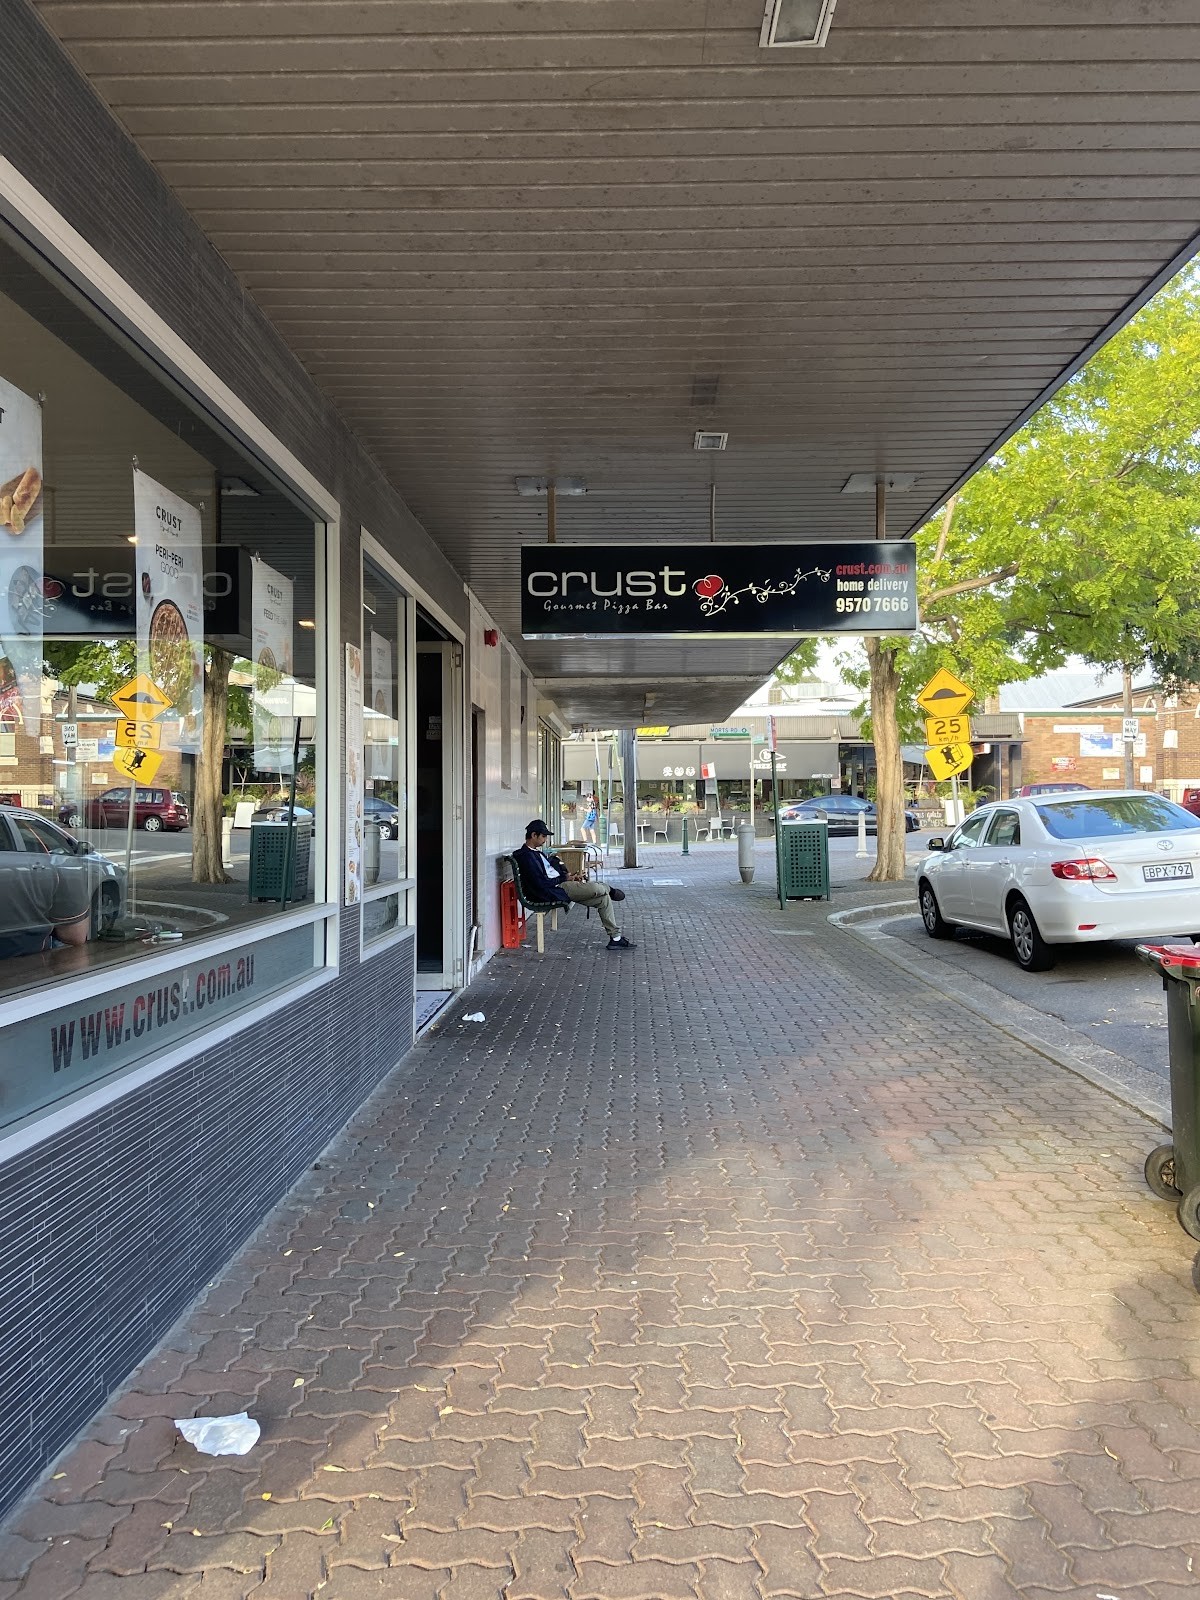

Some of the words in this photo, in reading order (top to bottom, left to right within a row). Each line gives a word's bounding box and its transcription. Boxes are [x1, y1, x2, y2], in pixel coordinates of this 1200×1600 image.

[155, 505, 182, 531] CRUST
[155, 543, 184, 568] PERI-PERI
[835, 562, 909, 576] crust.com.au
[527, 565, 687, 597] crust
[836, 578, 865, 592] home
[867, 578, 909, 593] delivery
[543, 599, 598, 611] Gourmet
[603, 598, 640, 615] Pizza
[645, 599, 669, 611] Bar
[835, 597, 872, 613] 9570
[873, 596, 909, 612] 7666
[934, 718, 961, 735] 25
[1125, 719, 1137, 727] ONE
[938, 735, 959, 743] km/h
